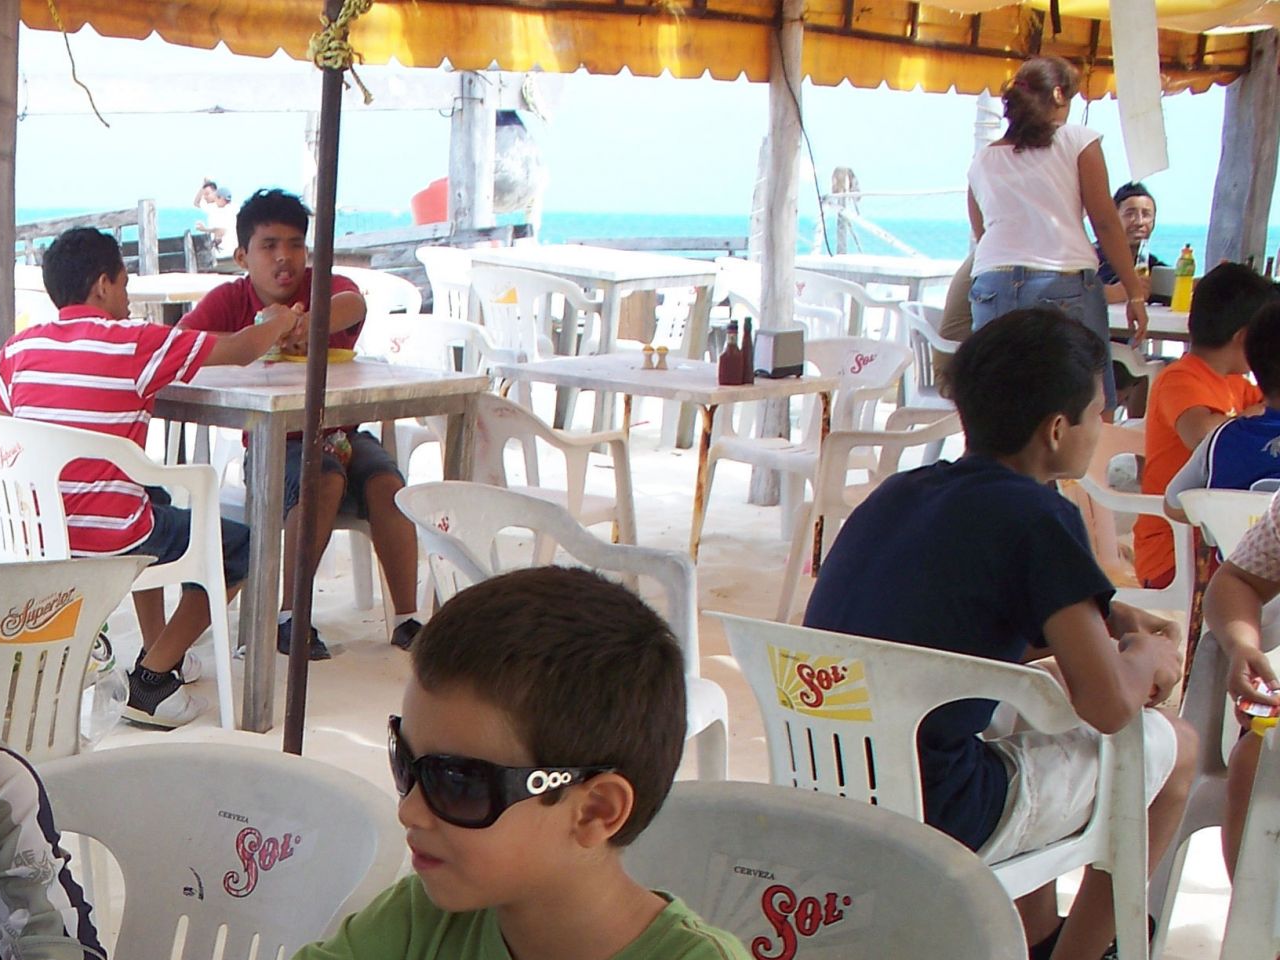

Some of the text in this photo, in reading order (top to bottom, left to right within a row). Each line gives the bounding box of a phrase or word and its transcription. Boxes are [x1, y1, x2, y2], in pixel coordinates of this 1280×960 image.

[0, 586, 75, 637] Superior
[218, 810, 249, 823] CERVEZA
[734, 866, 775, 880] CERVEZA
